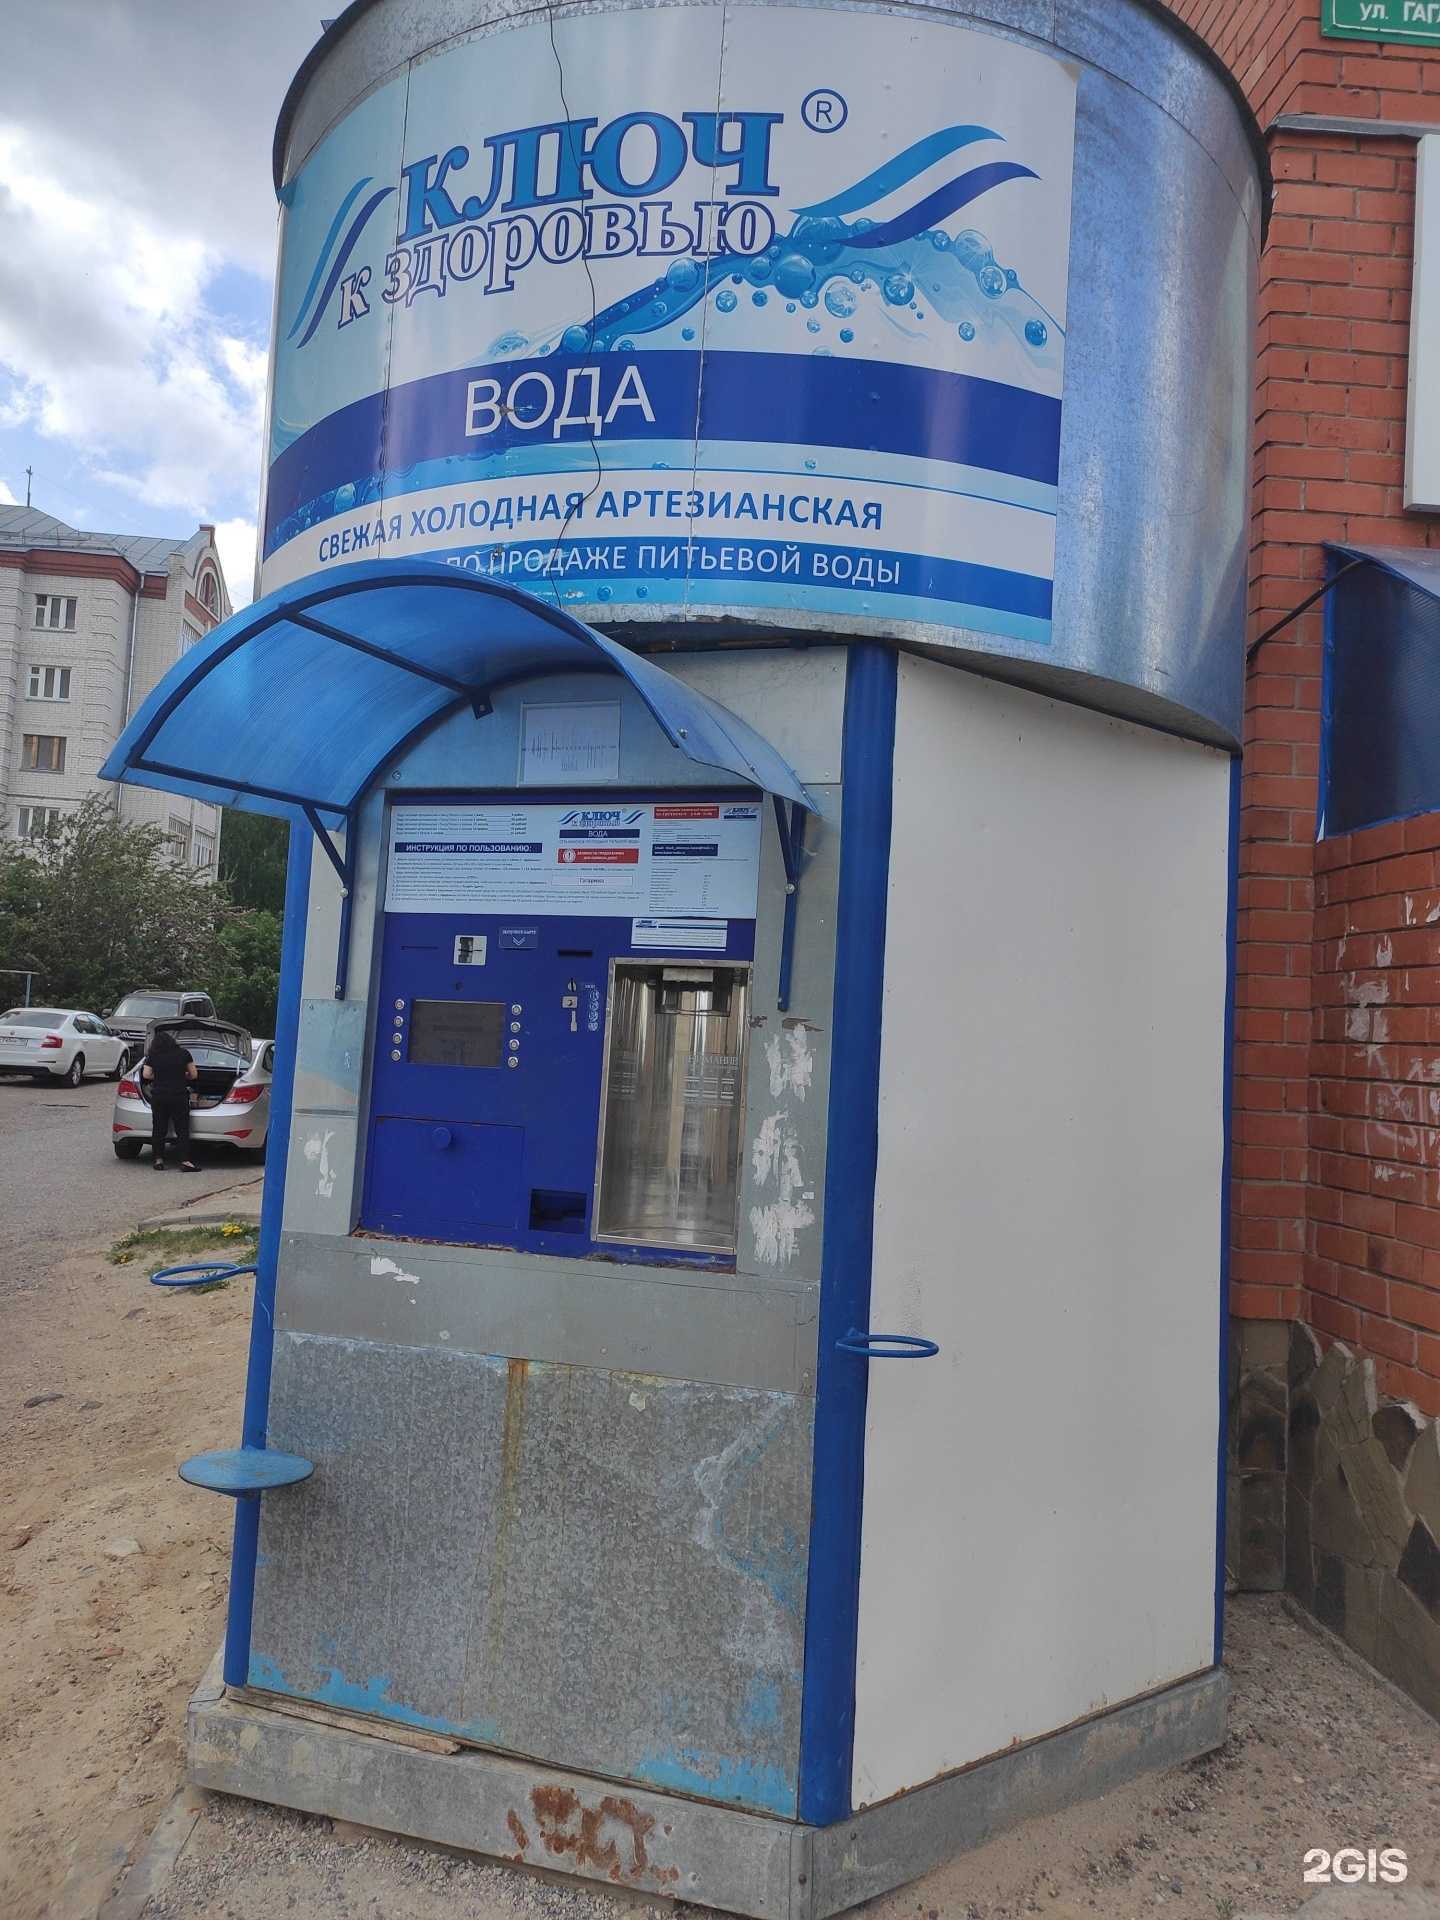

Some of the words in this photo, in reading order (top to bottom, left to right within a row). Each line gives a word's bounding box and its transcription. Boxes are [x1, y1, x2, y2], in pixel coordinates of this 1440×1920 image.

[1403, 1, 1440, 24] ГАГ
[396, 111, 784, 245] КЛЮЧ
[465, 366, 656, 438] ВОДА
[319, 514, 402, 561] СВЕЖАЯ
[410, 493, 583, 537] ХОЛОДНАЯ
[596, 490, 882, 530] АРТЕЗИАНСКАЯ
[489, 546, 627, 577] ПРОДАЖЕ
[638, 544, 800, 575] ПИТЬЕВОЙ
[812, 553, 900, 587] ВОДЫ
[406, 844, 455, 852] ИНСТРУКЦИЯ
[588, 830, 608, 838] ВОДА
